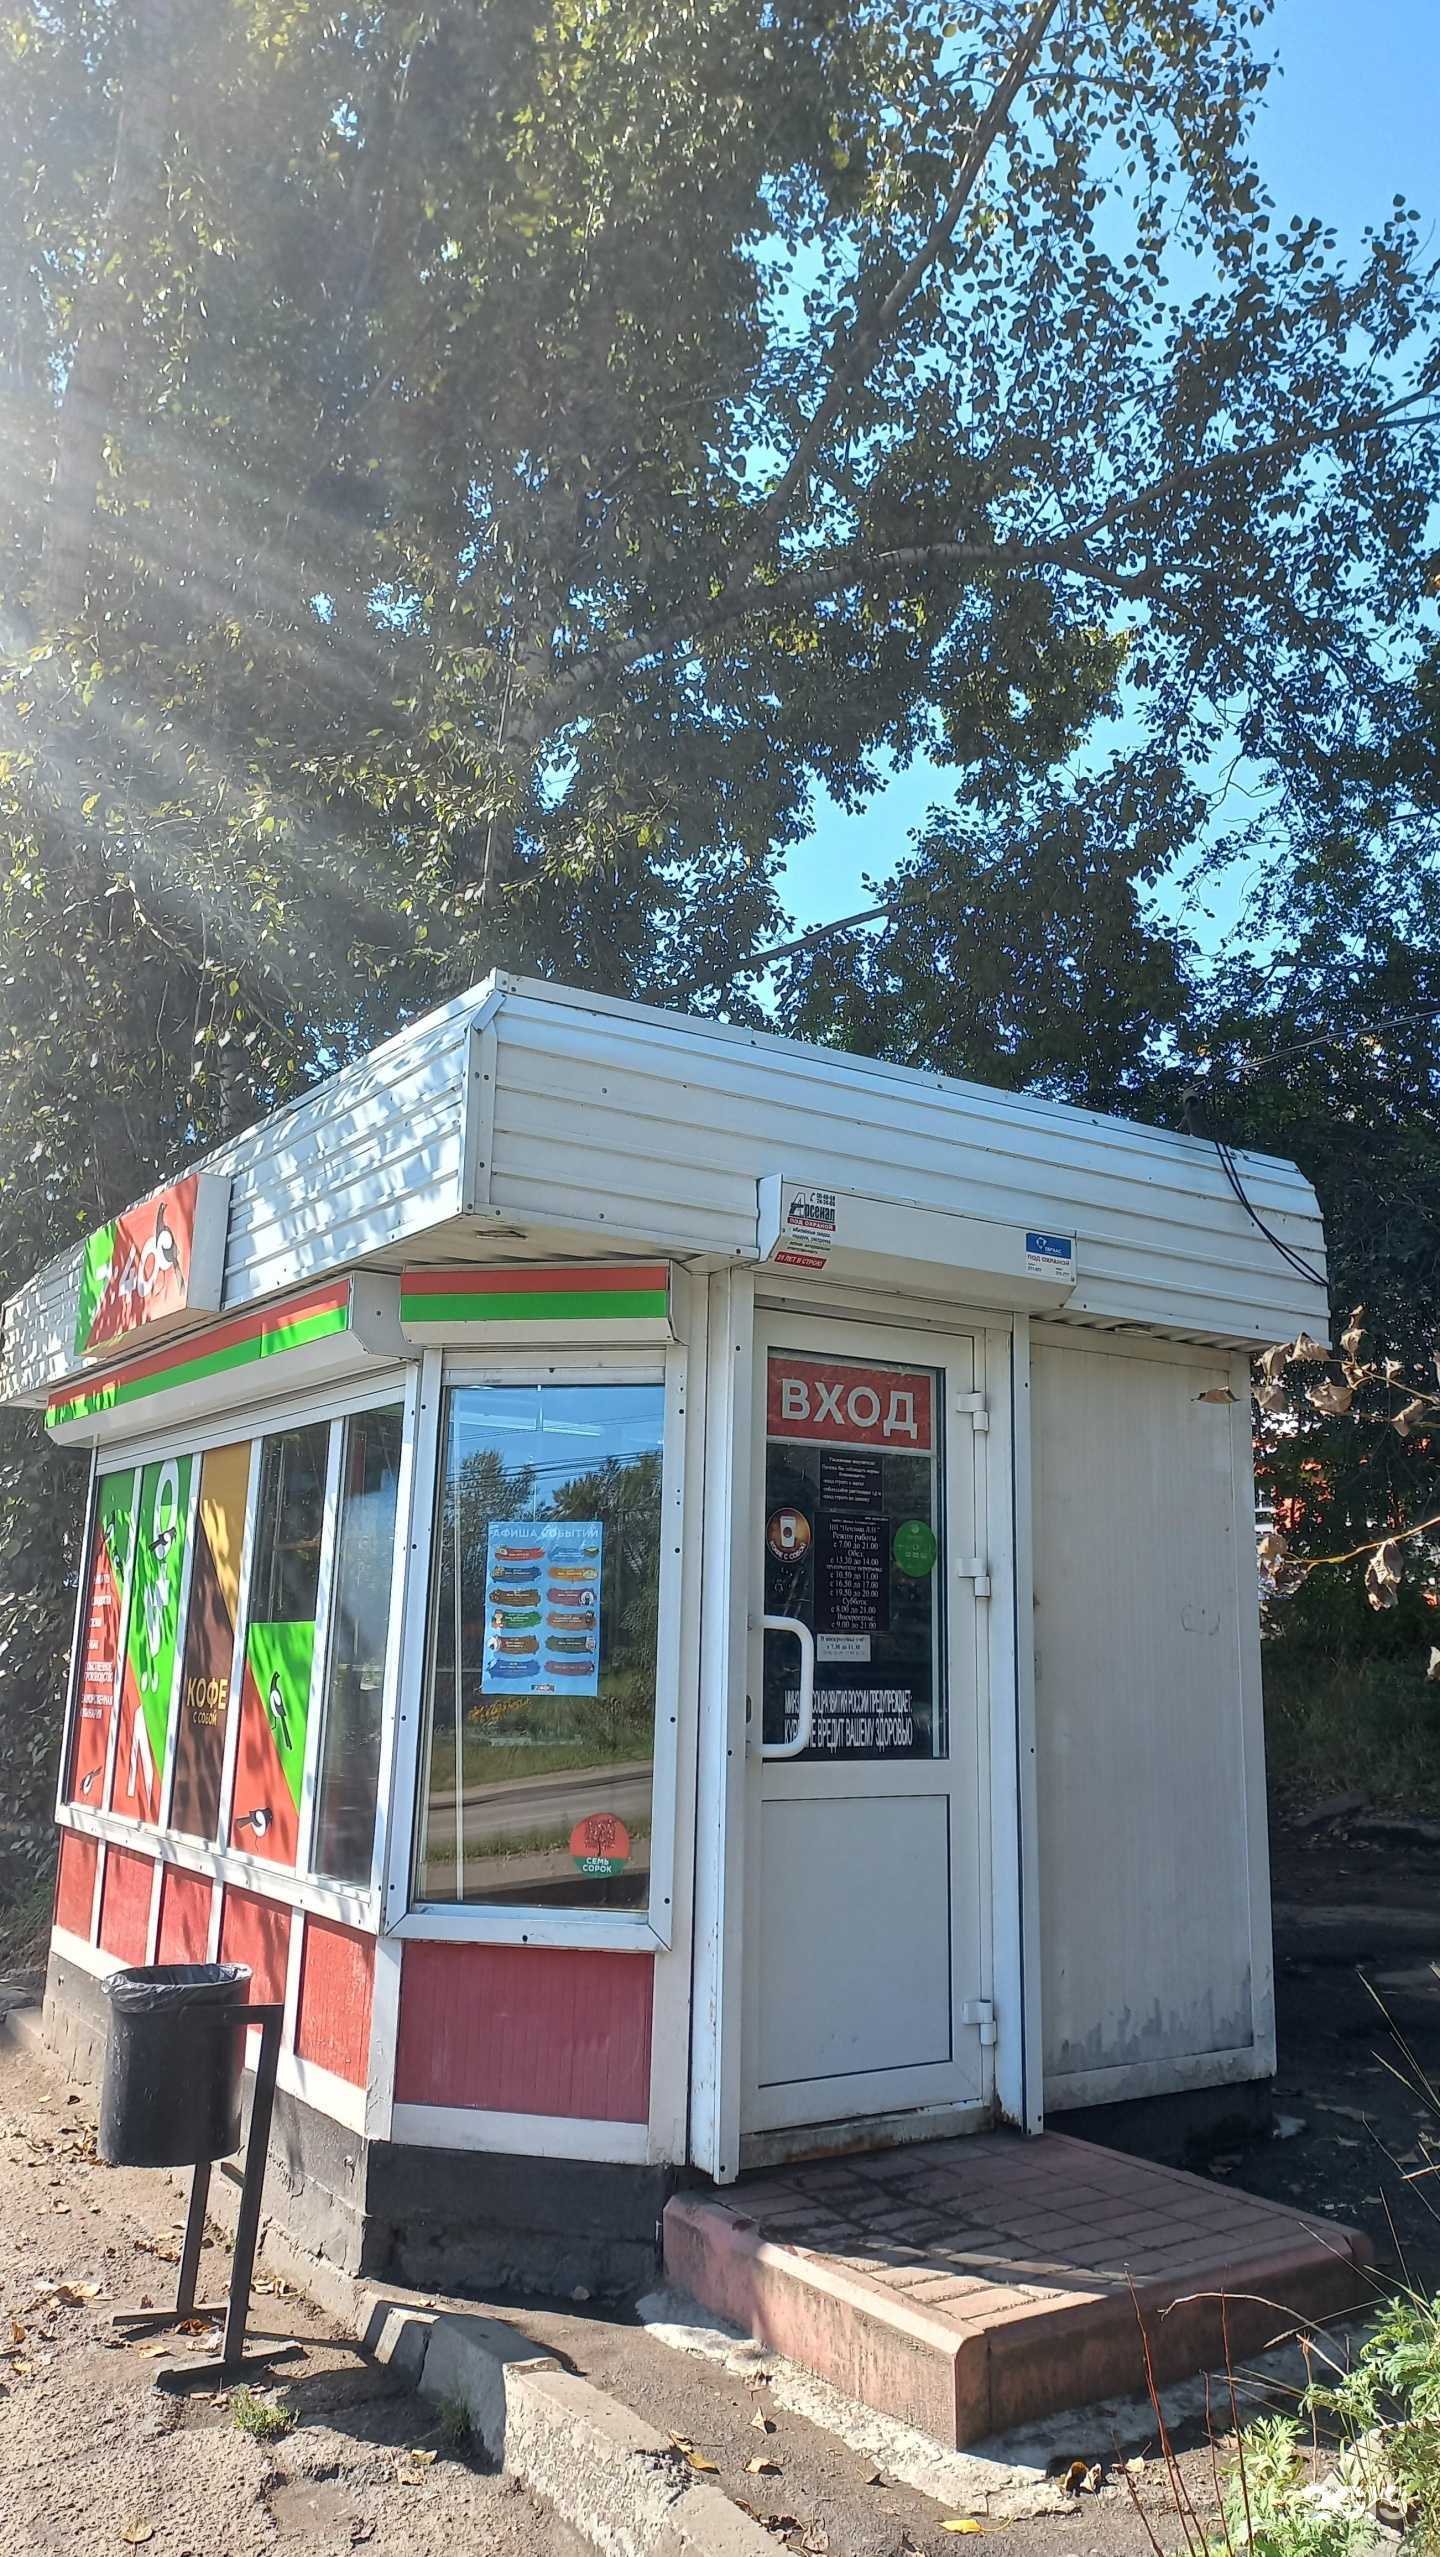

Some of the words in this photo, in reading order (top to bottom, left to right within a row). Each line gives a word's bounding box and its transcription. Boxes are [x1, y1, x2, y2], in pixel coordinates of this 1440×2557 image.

[788, 1191, 836, 1222] Арсенал
[789, 1217, 804, 1227] ПОД
[804, 1219, 834, 1231] ОХРАНОЙ
[784, 1254, 796, 1263] ЛЕТ
[802, 1257, 823, 1267] СТРОЮ
[1027, 1254, 1041, 1262] ПОД
[1041, 1256, 1070, 1266] ОХРАНОЙ
[781, 1378, 918, 1440] ВХОД
[492, 1527, 538, 1538] АФИША
[541, 1524, 599, 1539] СОБЫТИЙ
[788, 1542, 807, 1560] СОБОЙ
[861, 1541, 879, 1550] 21.00
[186, 1676, 229, 1710] КОФЕ
[848, 1690, 869, 1713] РОССИИ
[197, 1709, 218, 1726] СОБОЙ
[784, 1718, 816, 1748] КУРЕ
[817, 1718, 845, 1754] ВРЕДИТ
[846, 1718, 875, 1748] ВАШЕМУ
[875, 1717, 913, 1753] ЗДОРОВЬЮ
[582, 1864, 612, 1873] СОРОК
[585, 1857, 610, 1866] СЕМЬ
